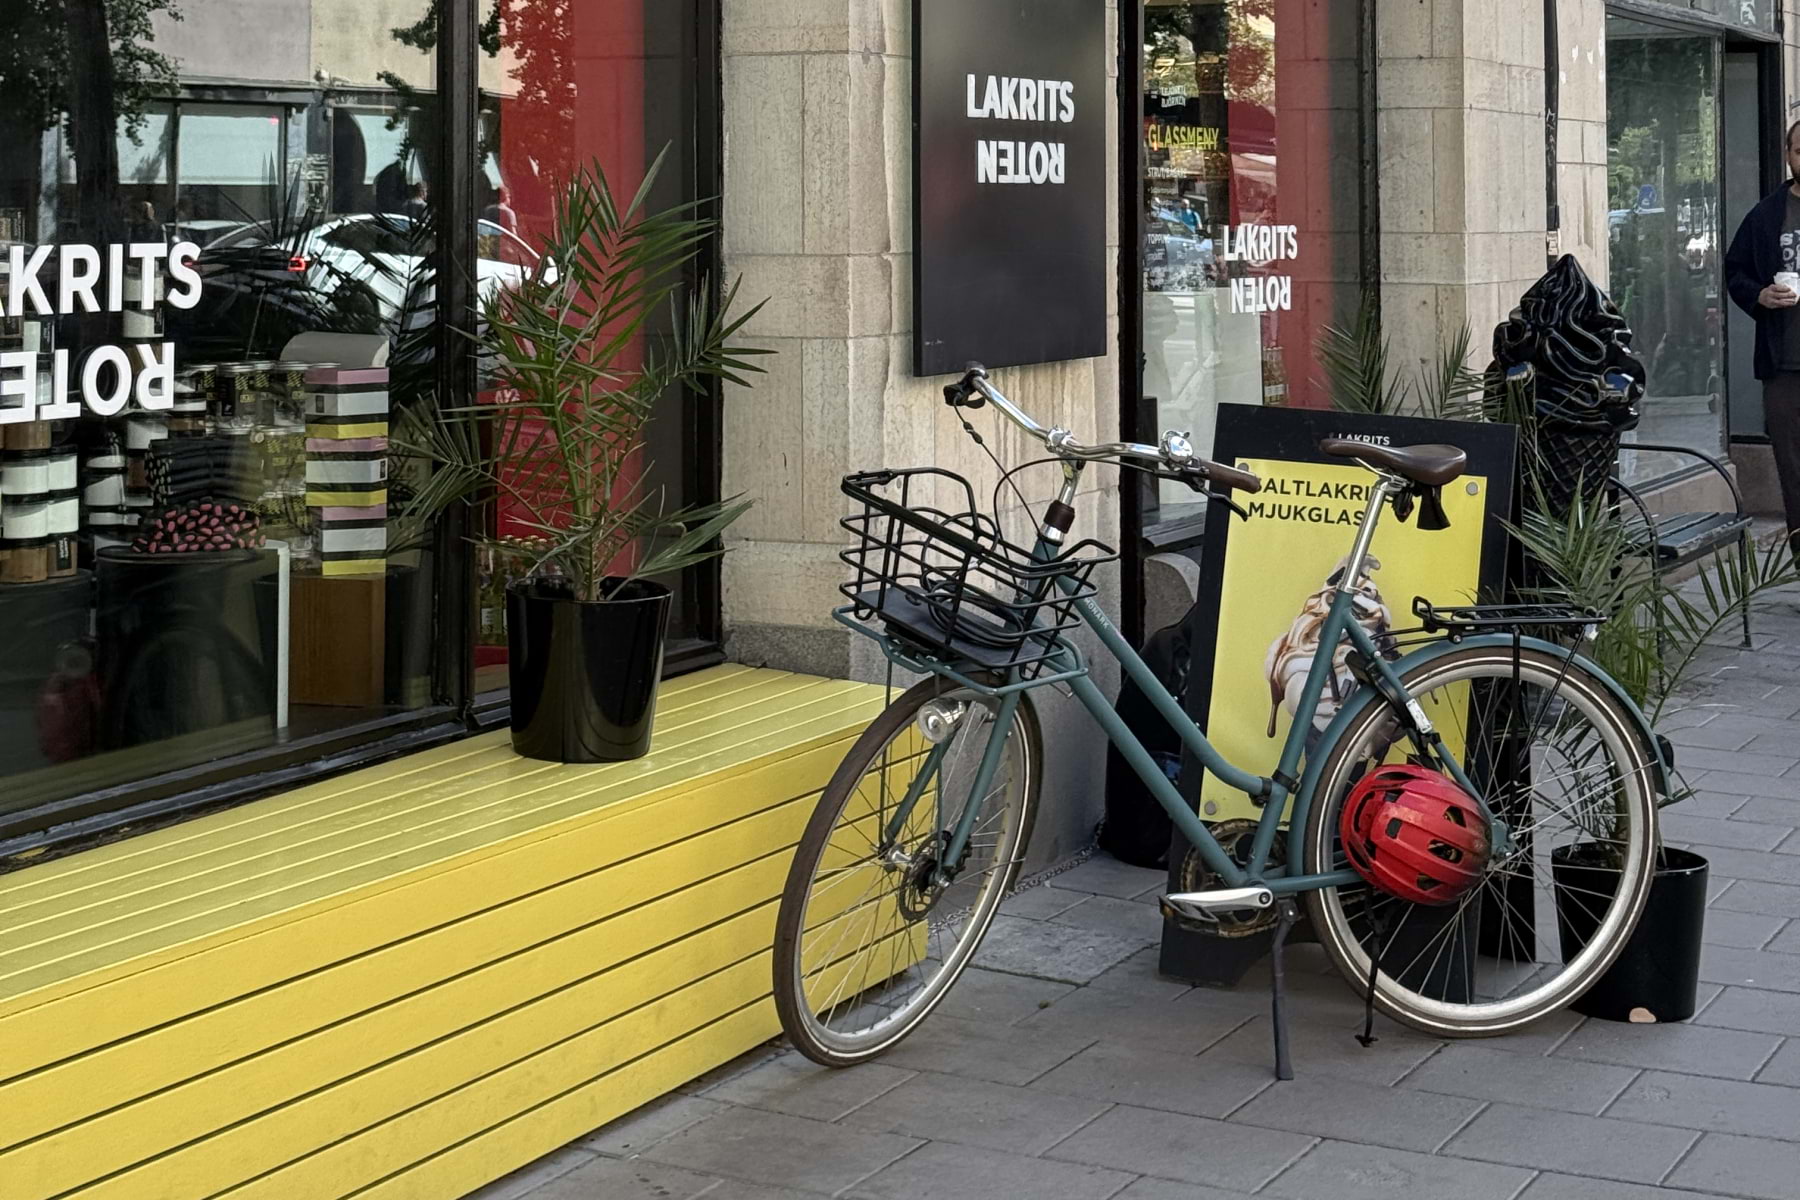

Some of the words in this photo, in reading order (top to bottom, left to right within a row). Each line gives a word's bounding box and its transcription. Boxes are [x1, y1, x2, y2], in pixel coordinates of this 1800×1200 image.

[966, 73, 1075, 123] LAKRITS
[1148, 124, 1219, 151] GLASSMENY
[977, 140, 1065, 184] ROTEN
[1223, 224, 1298, 261] LAKRITS
[0, 241, 203, 317] KRITS
[1230, 276, 1292, 314] ROTEN
[1258, 477, 1393, 503] ALTLAKRI
[1248, 502, 1378, 527] MJUKGLAS
